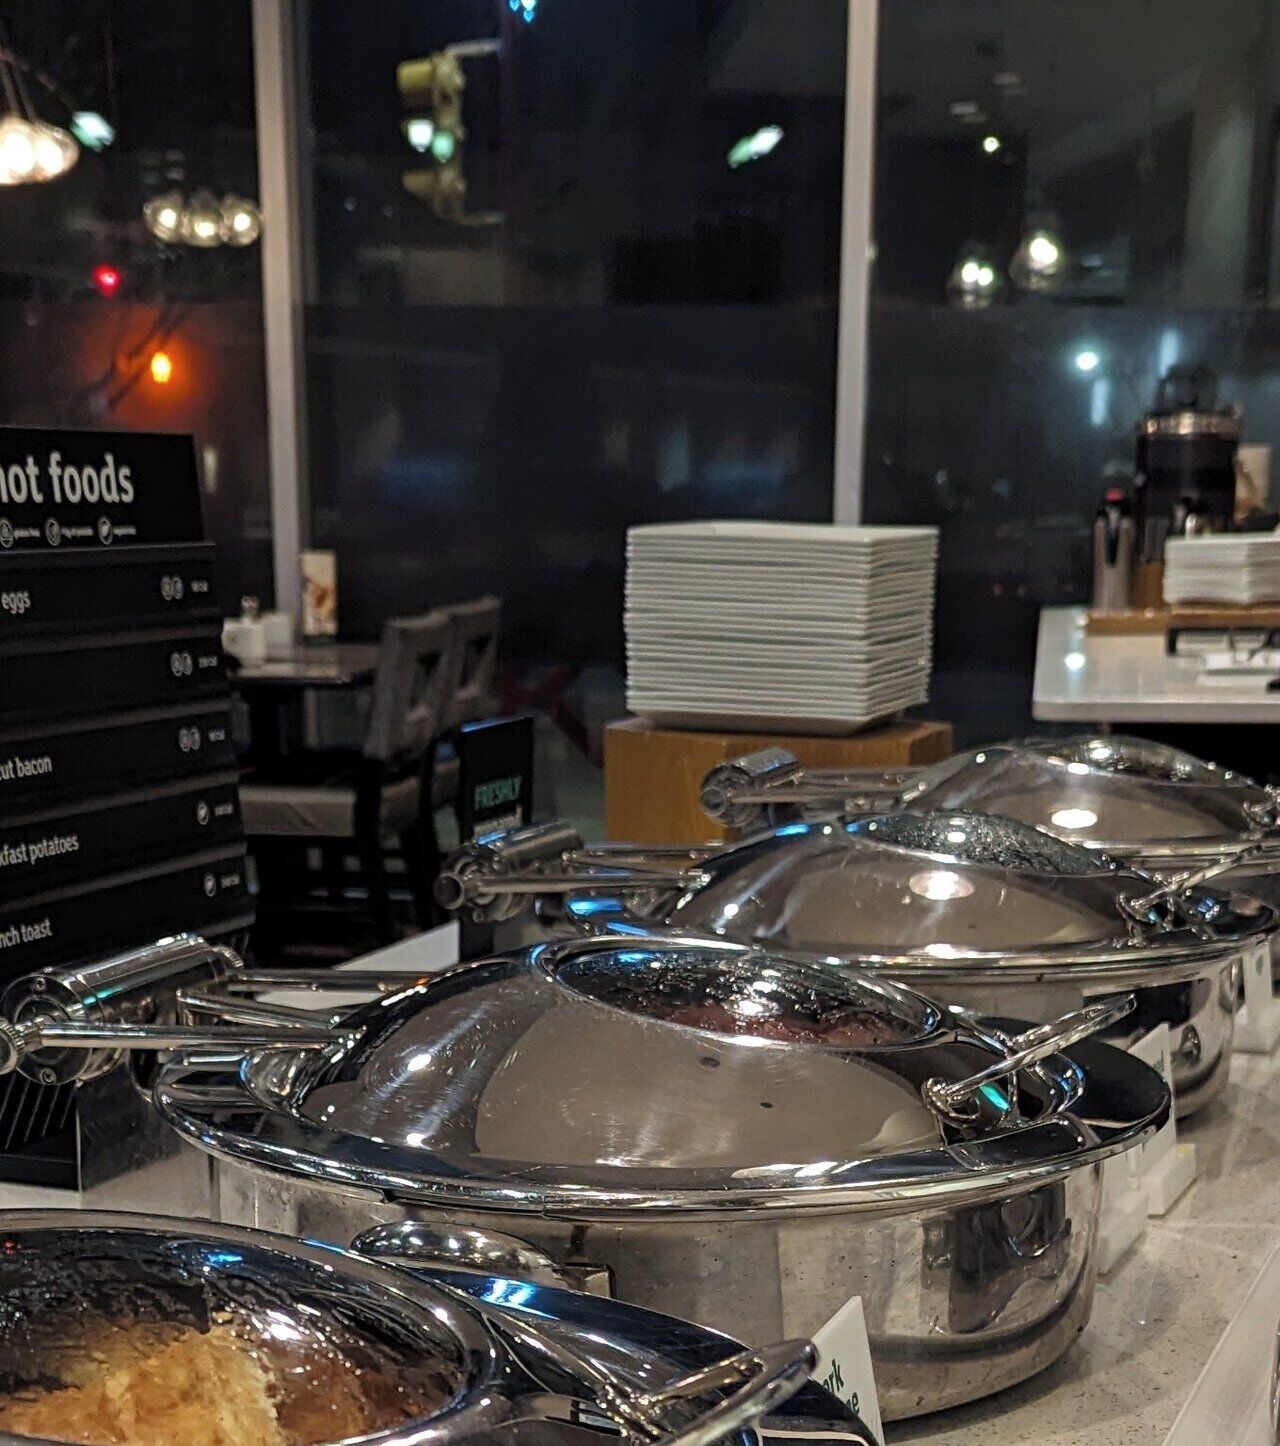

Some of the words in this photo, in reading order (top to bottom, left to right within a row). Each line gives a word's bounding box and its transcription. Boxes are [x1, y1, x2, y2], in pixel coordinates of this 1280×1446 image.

[48, 449, 134, 504] foods
[1, 590, 31, 614] eggs
[16, 755, 53, 778] bacon
[29, 834, 79, 865] potatoes
[21, 918, 53, 944] toast
